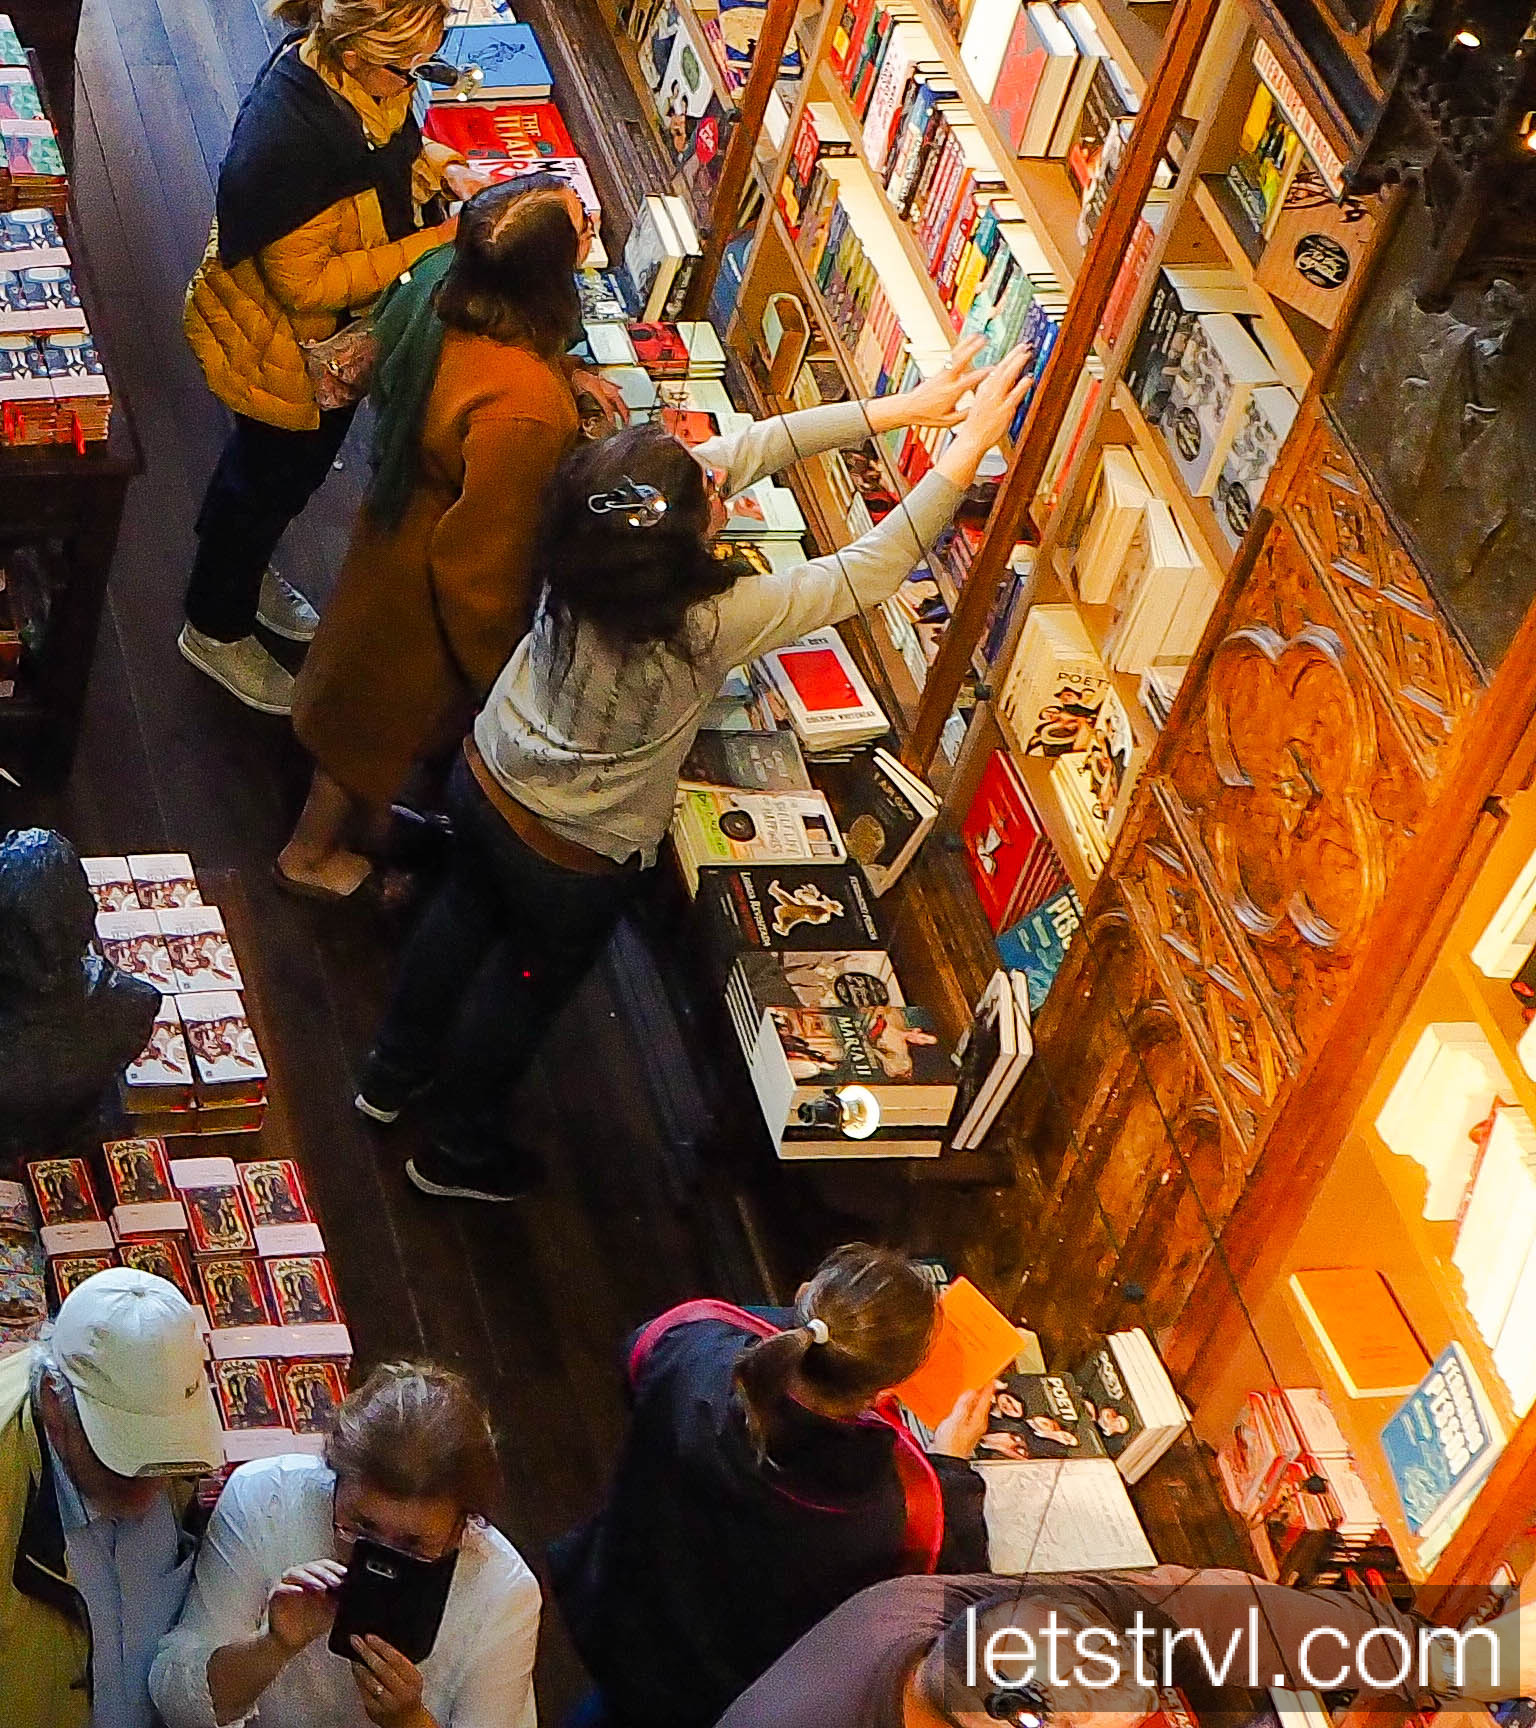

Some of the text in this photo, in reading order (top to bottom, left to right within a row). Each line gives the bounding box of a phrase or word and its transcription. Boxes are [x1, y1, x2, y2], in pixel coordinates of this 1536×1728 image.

[521, 112, 542, 137] THE
[837, 1015, 873, 1076] MARIA II
